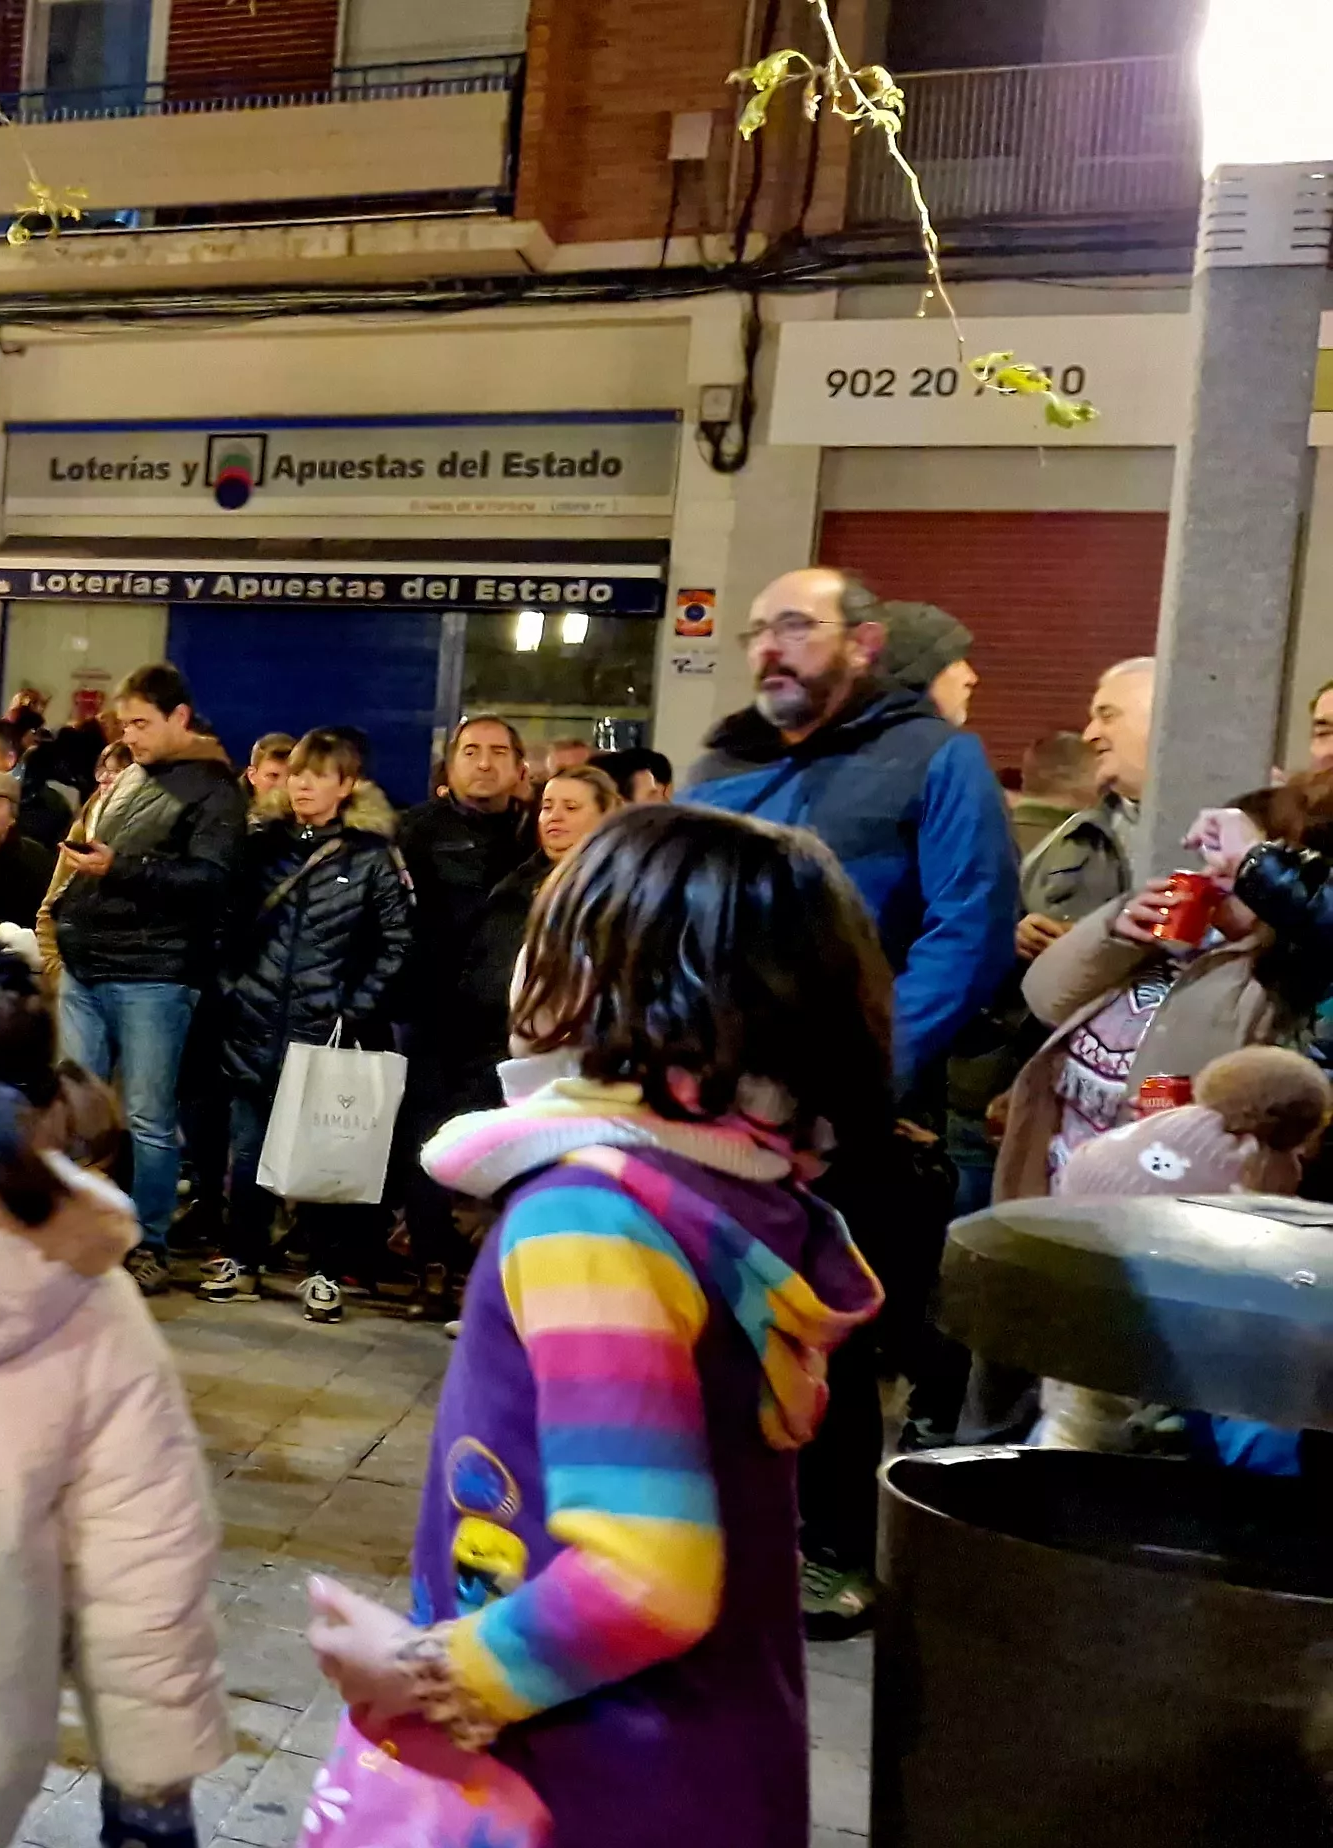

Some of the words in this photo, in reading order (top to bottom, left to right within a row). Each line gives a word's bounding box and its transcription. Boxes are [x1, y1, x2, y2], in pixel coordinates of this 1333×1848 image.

[826, 368, 897, 398] 902
[909, 367, 959, 397] 20
[49, 455, 171, 482] Loterías
[180, 461, 200, 487] y
[272, 453, 425, 487] Apuestas
[436, 450, 491, 478] del
[501, 448, 624, 478] Estado
[30, 571, 171, 596] Loterías
[184, 577, 205, 599] y
[211, 574, 386, 600] Apuestas
[400, 577, 460, 600] del
[475, 579, 614, 602] Estado
